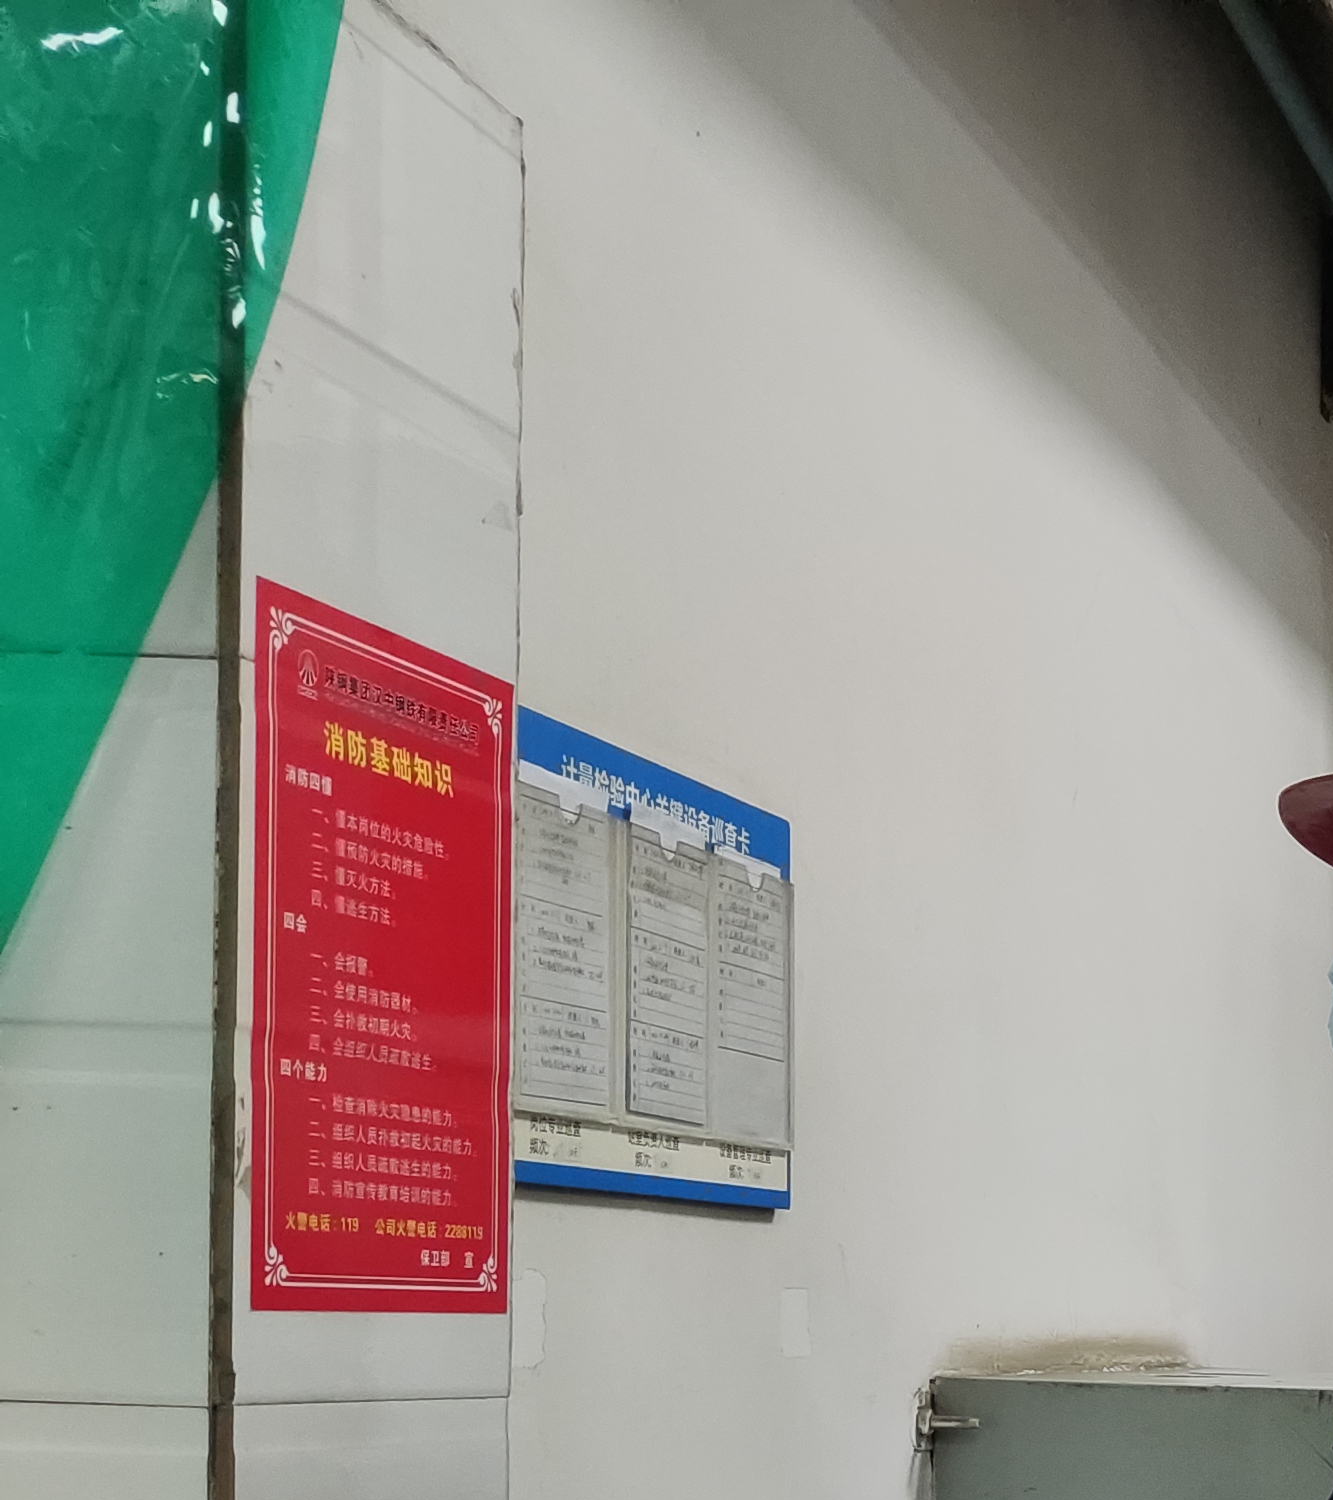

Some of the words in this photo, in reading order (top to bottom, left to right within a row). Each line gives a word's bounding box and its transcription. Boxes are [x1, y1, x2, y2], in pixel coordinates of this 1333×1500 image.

[323, 721, 455, 798] 消防基础知识
[284, 764, 333, 797] 消防四懂
[283, 911, 308, 934] 四会
[280, 1058, 328, 1083] 四个能力
[420, 1249, 450, 1267] 保卫部
